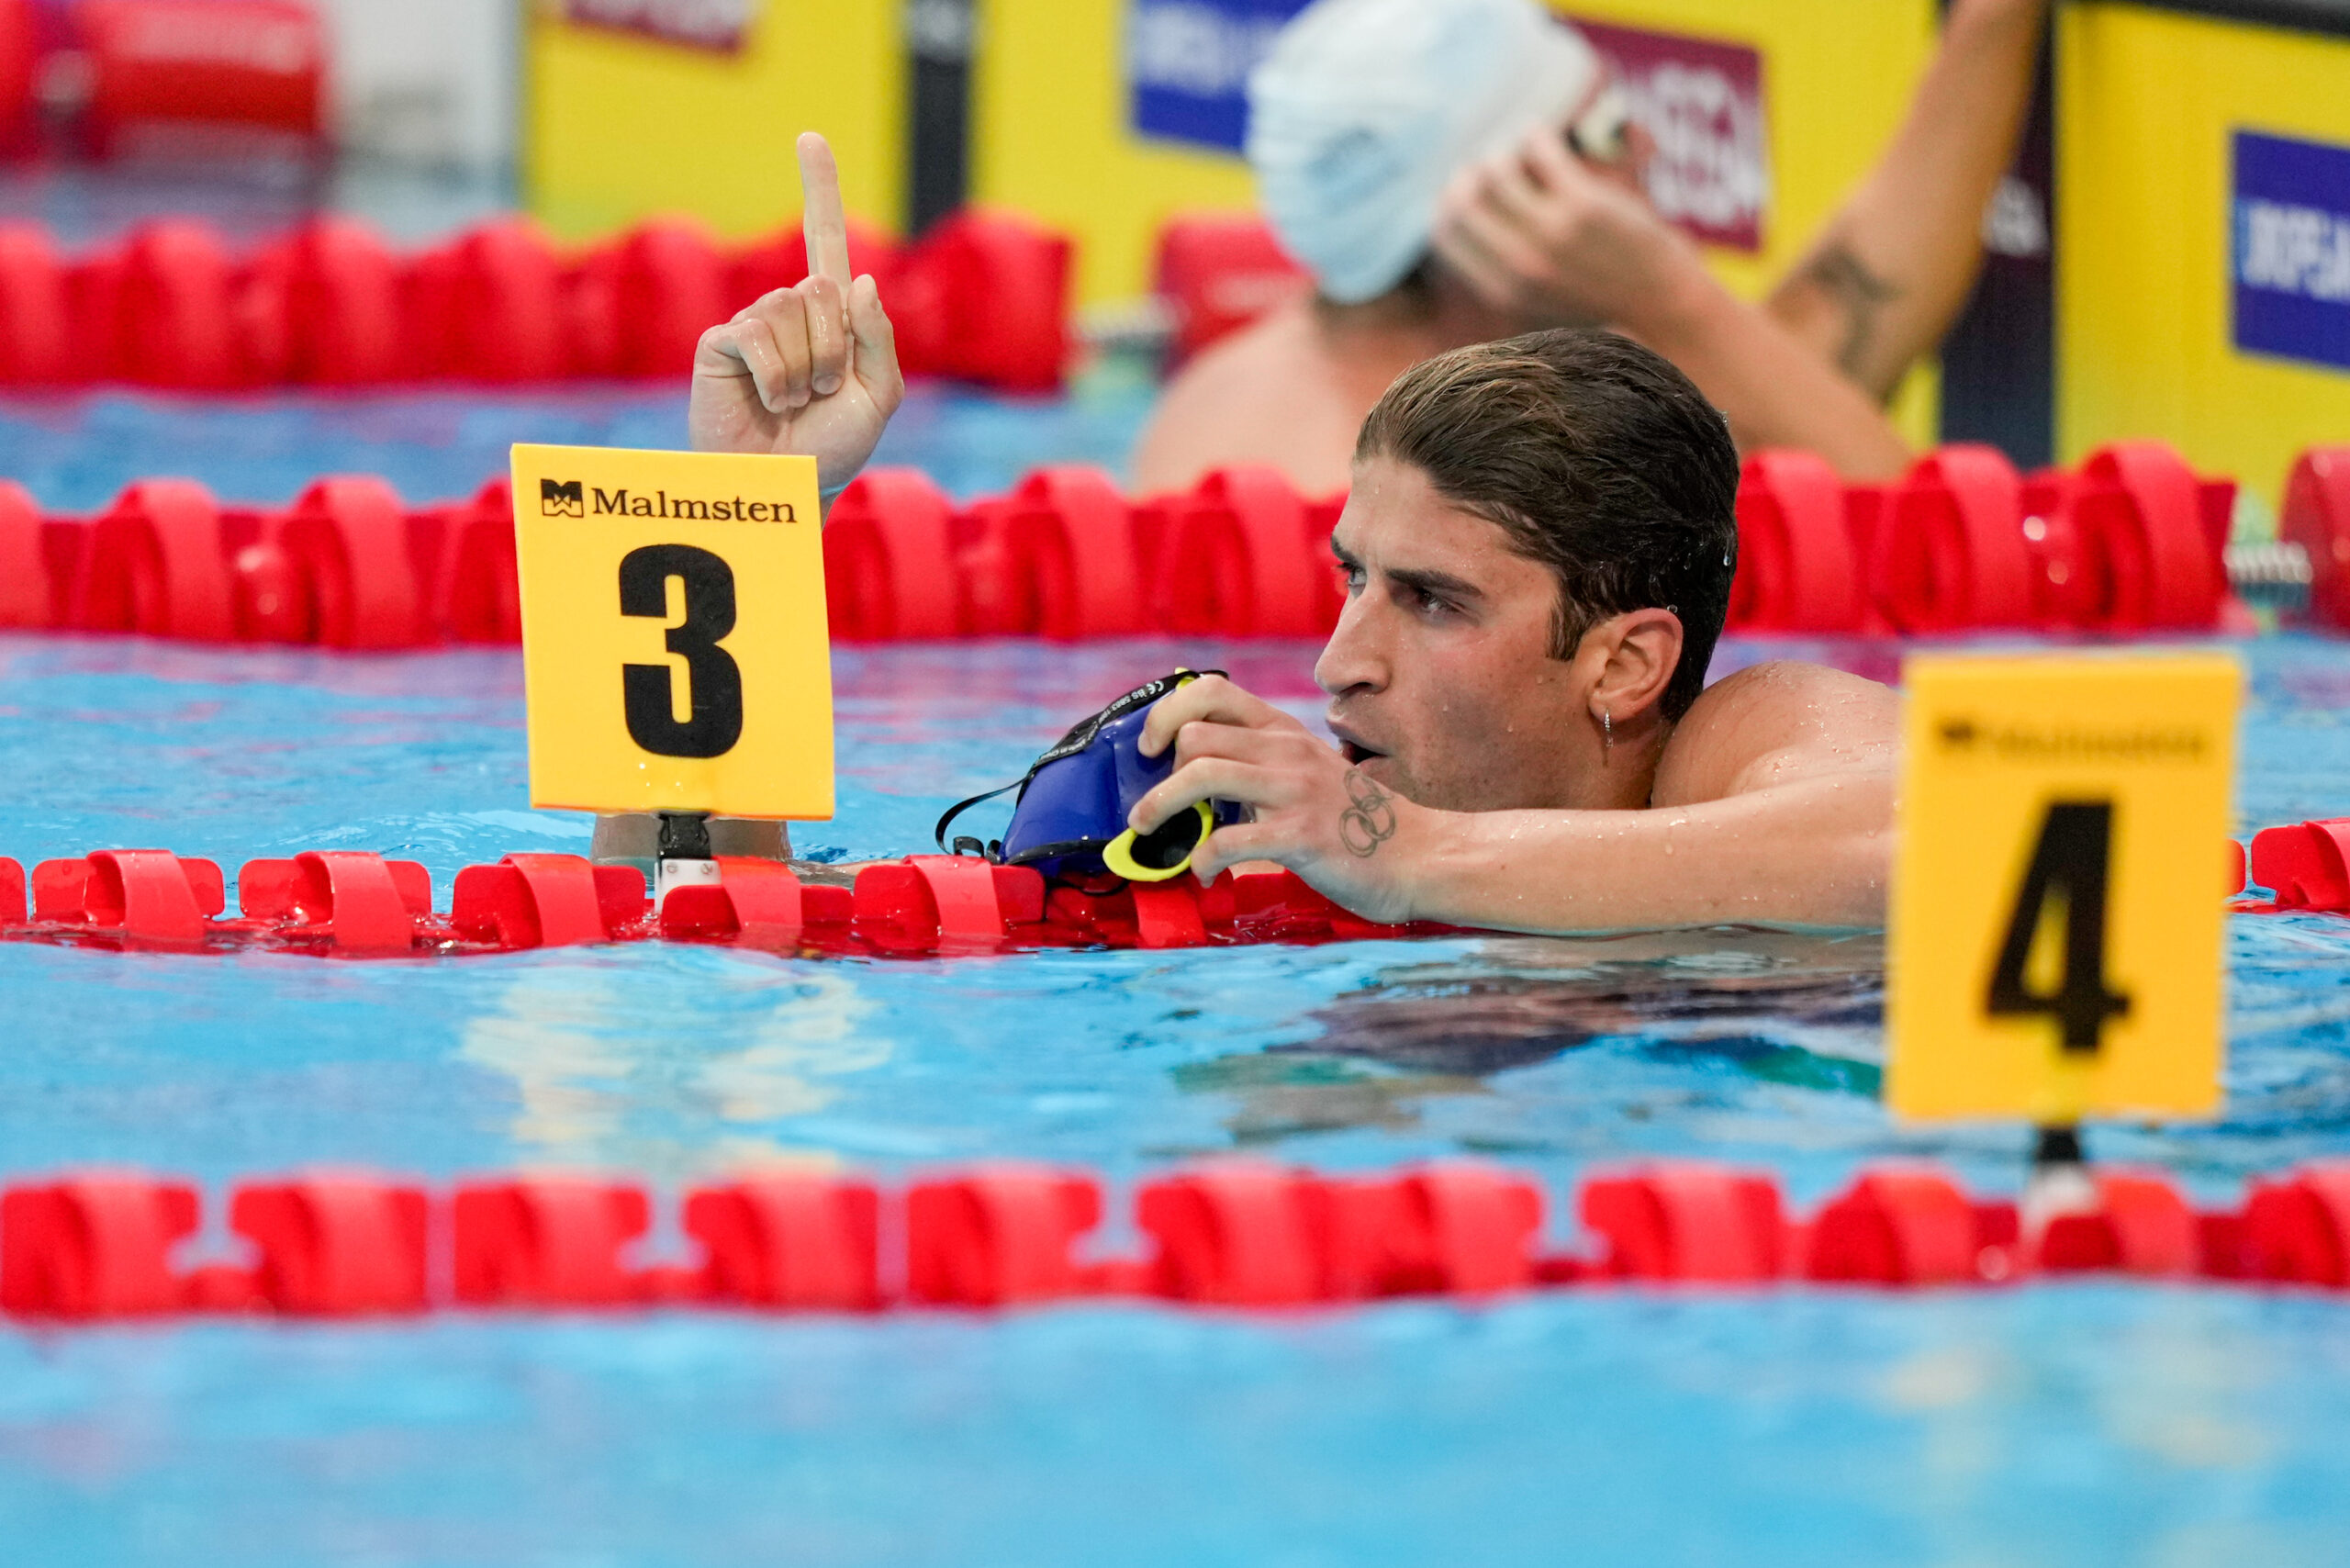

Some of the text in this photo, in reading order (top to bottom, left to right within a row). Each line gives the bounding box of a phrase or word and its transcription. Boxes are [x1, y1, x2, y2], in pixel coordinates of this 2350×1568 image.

[591, 487, 797, 523] Malmsten
[619, 543, 743, 758] 3
[1983, 799, 2134, 1052] 4
